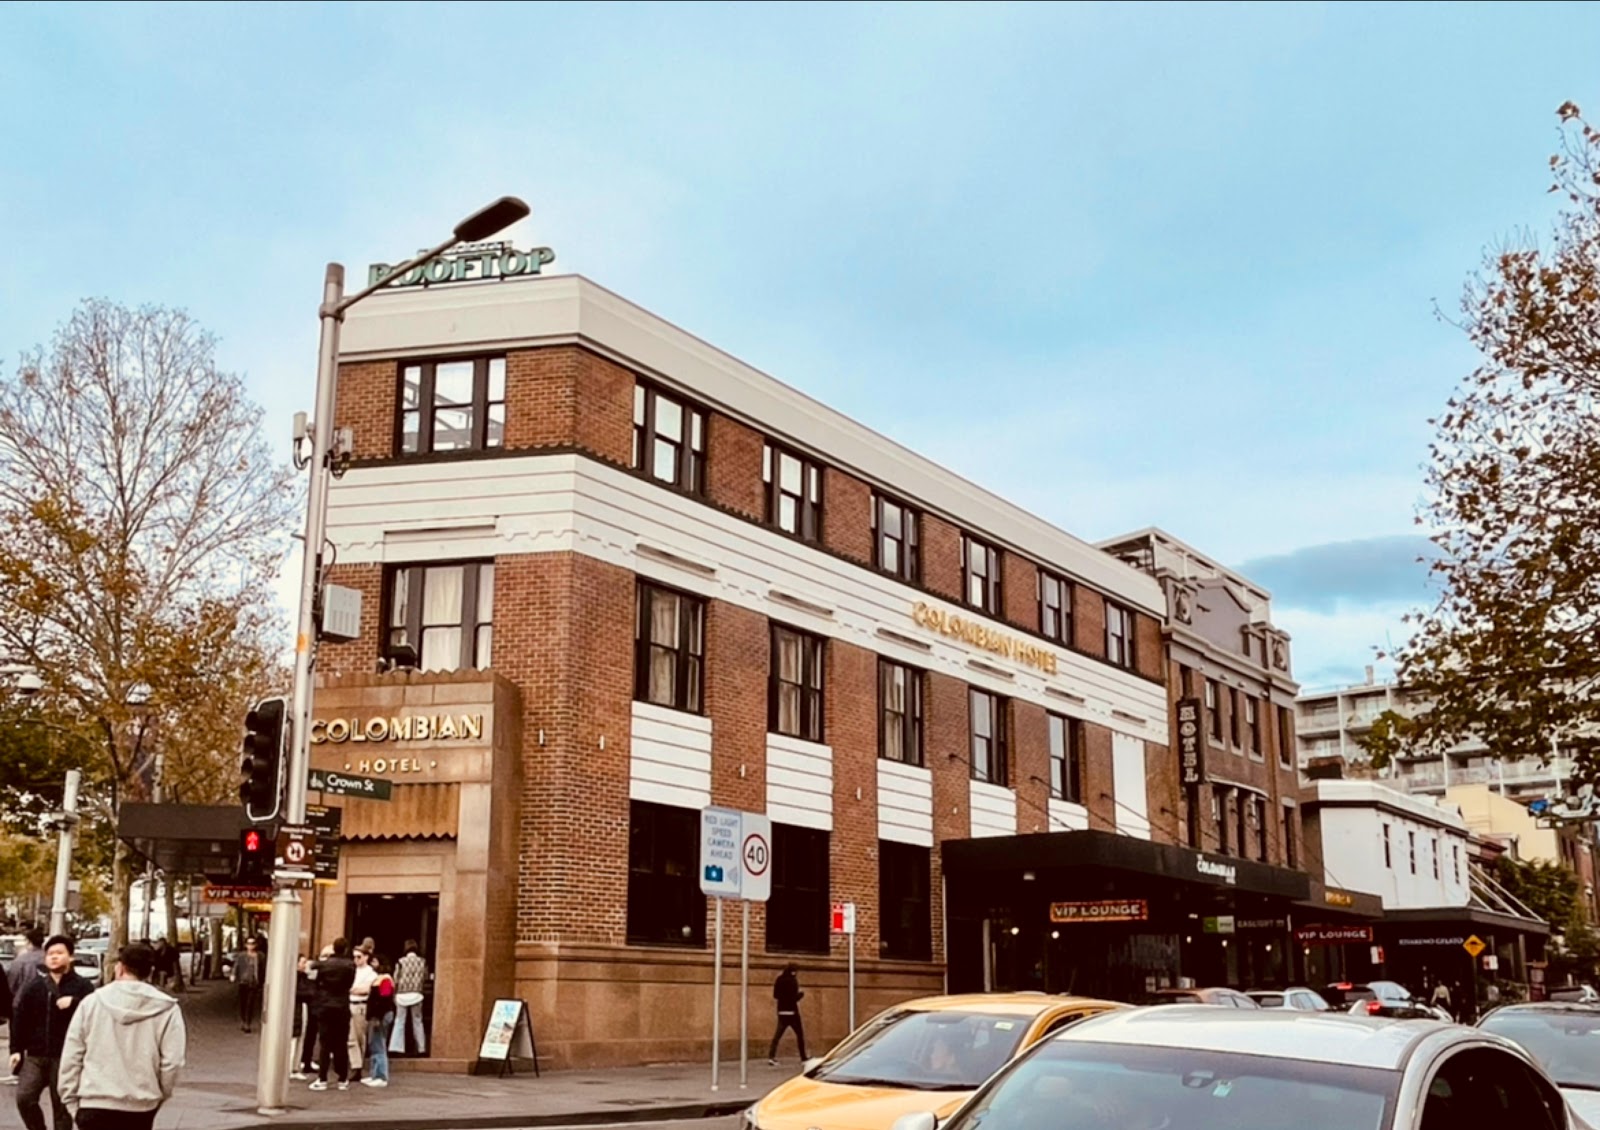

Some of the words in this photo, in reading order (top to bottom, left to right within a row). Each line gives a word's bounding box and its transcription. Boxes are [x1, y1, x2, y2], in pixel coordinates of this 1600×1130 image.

[368, 246, 556, 288] ROOFTOP
[913, 601, 1012, 659] COLOMBIAN
[1013, 637, 1059, 676] HOTEL
[309, 714, 482, 745] COLOMBIAN
[359, 759, 422, 774] HOTEL
[327, 774, 363, 790] Crown
[364, 779, 375, 792] St
[704, 814, 718, 826] RED
[720, 818, 738, 829] LIGHT
[711, 828, 732, 839] SPEED
[707, 837, 735, 849] CAMERA
[710, 850, 733, 860] AHEAD
[747, 845, 765, 865] 40
[207, 889, 230, 898] VIP
[233, 890, 273, 899] LOUN
[1054, 906, 1077, 917] VIP
[1081, 904, 1141, 917] LOUNGE
[1298, 931, 1317, 940] VIP
[1319, 930, 1368, 939] LOUNGE
